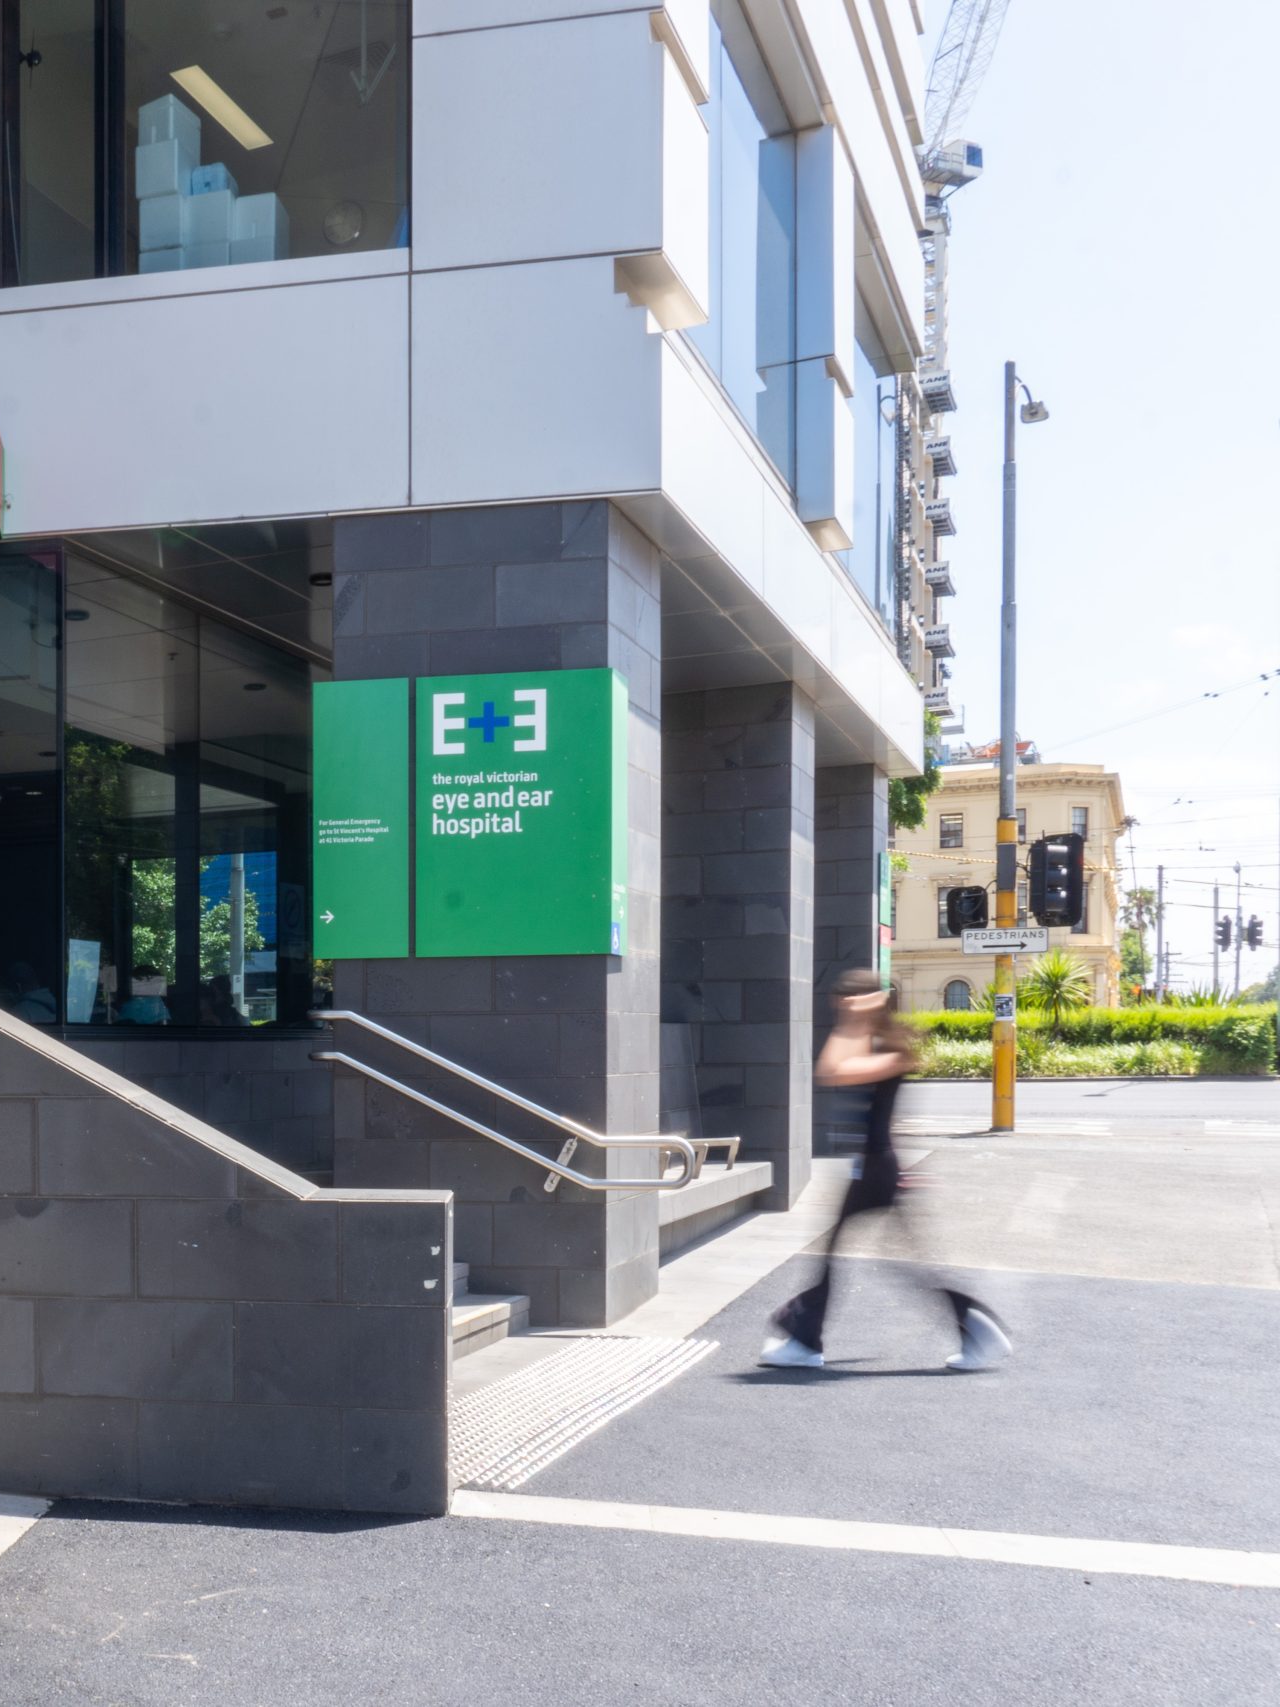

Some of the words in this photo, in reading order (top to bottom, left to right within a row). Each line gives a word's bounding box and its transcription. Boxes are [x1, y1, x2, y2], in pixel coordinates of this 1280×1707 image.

[432, 773, 452, 785] the
[455, 771, 484, 786] royal
[487, 771, 538, 783] victorian
[432, 792, 470, 814] eye
[473, 785, 514, 809] and
[517, 790, 553, 807] ear
[432, 810, 523, 839] hospital
[966, 931, 1045, 940] PEDESTRIANS
